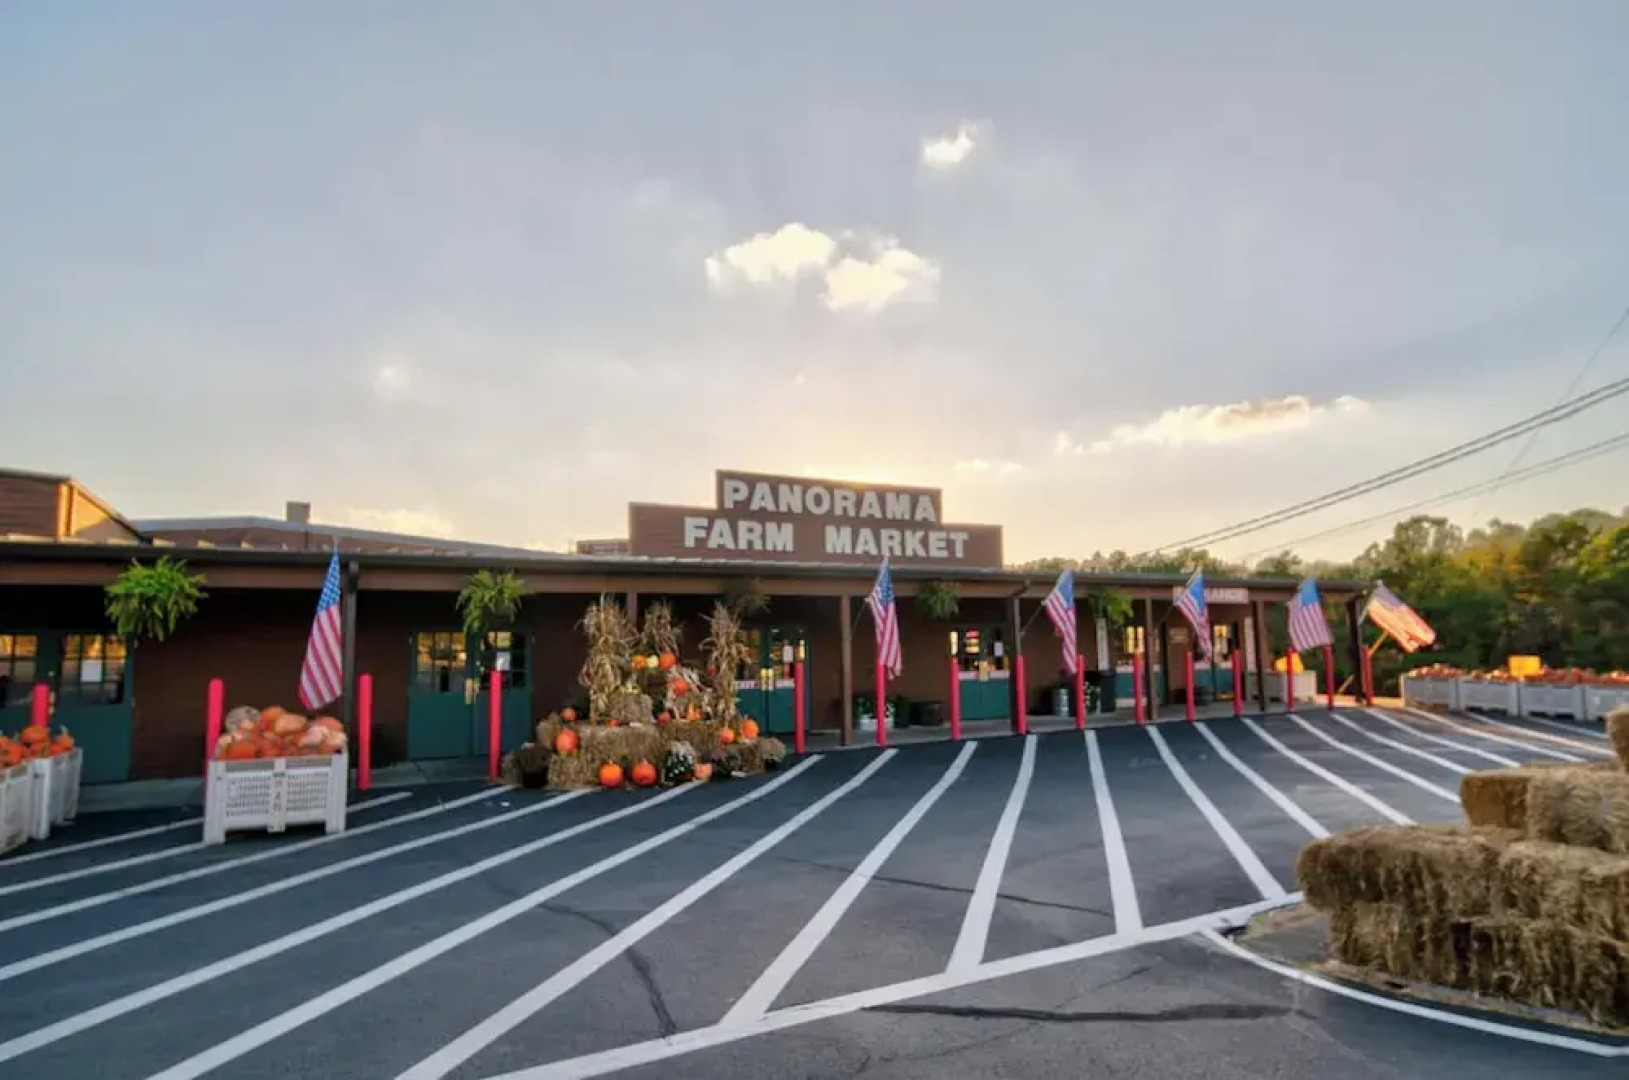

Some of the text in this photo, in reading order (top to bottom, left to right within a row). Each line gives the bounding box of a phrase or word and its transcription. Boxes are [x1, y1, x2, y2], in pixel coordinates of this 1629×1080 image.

[723, 479, 937, 522] PANORAMA
[683, 516, 969, 559] FARM MARKET
